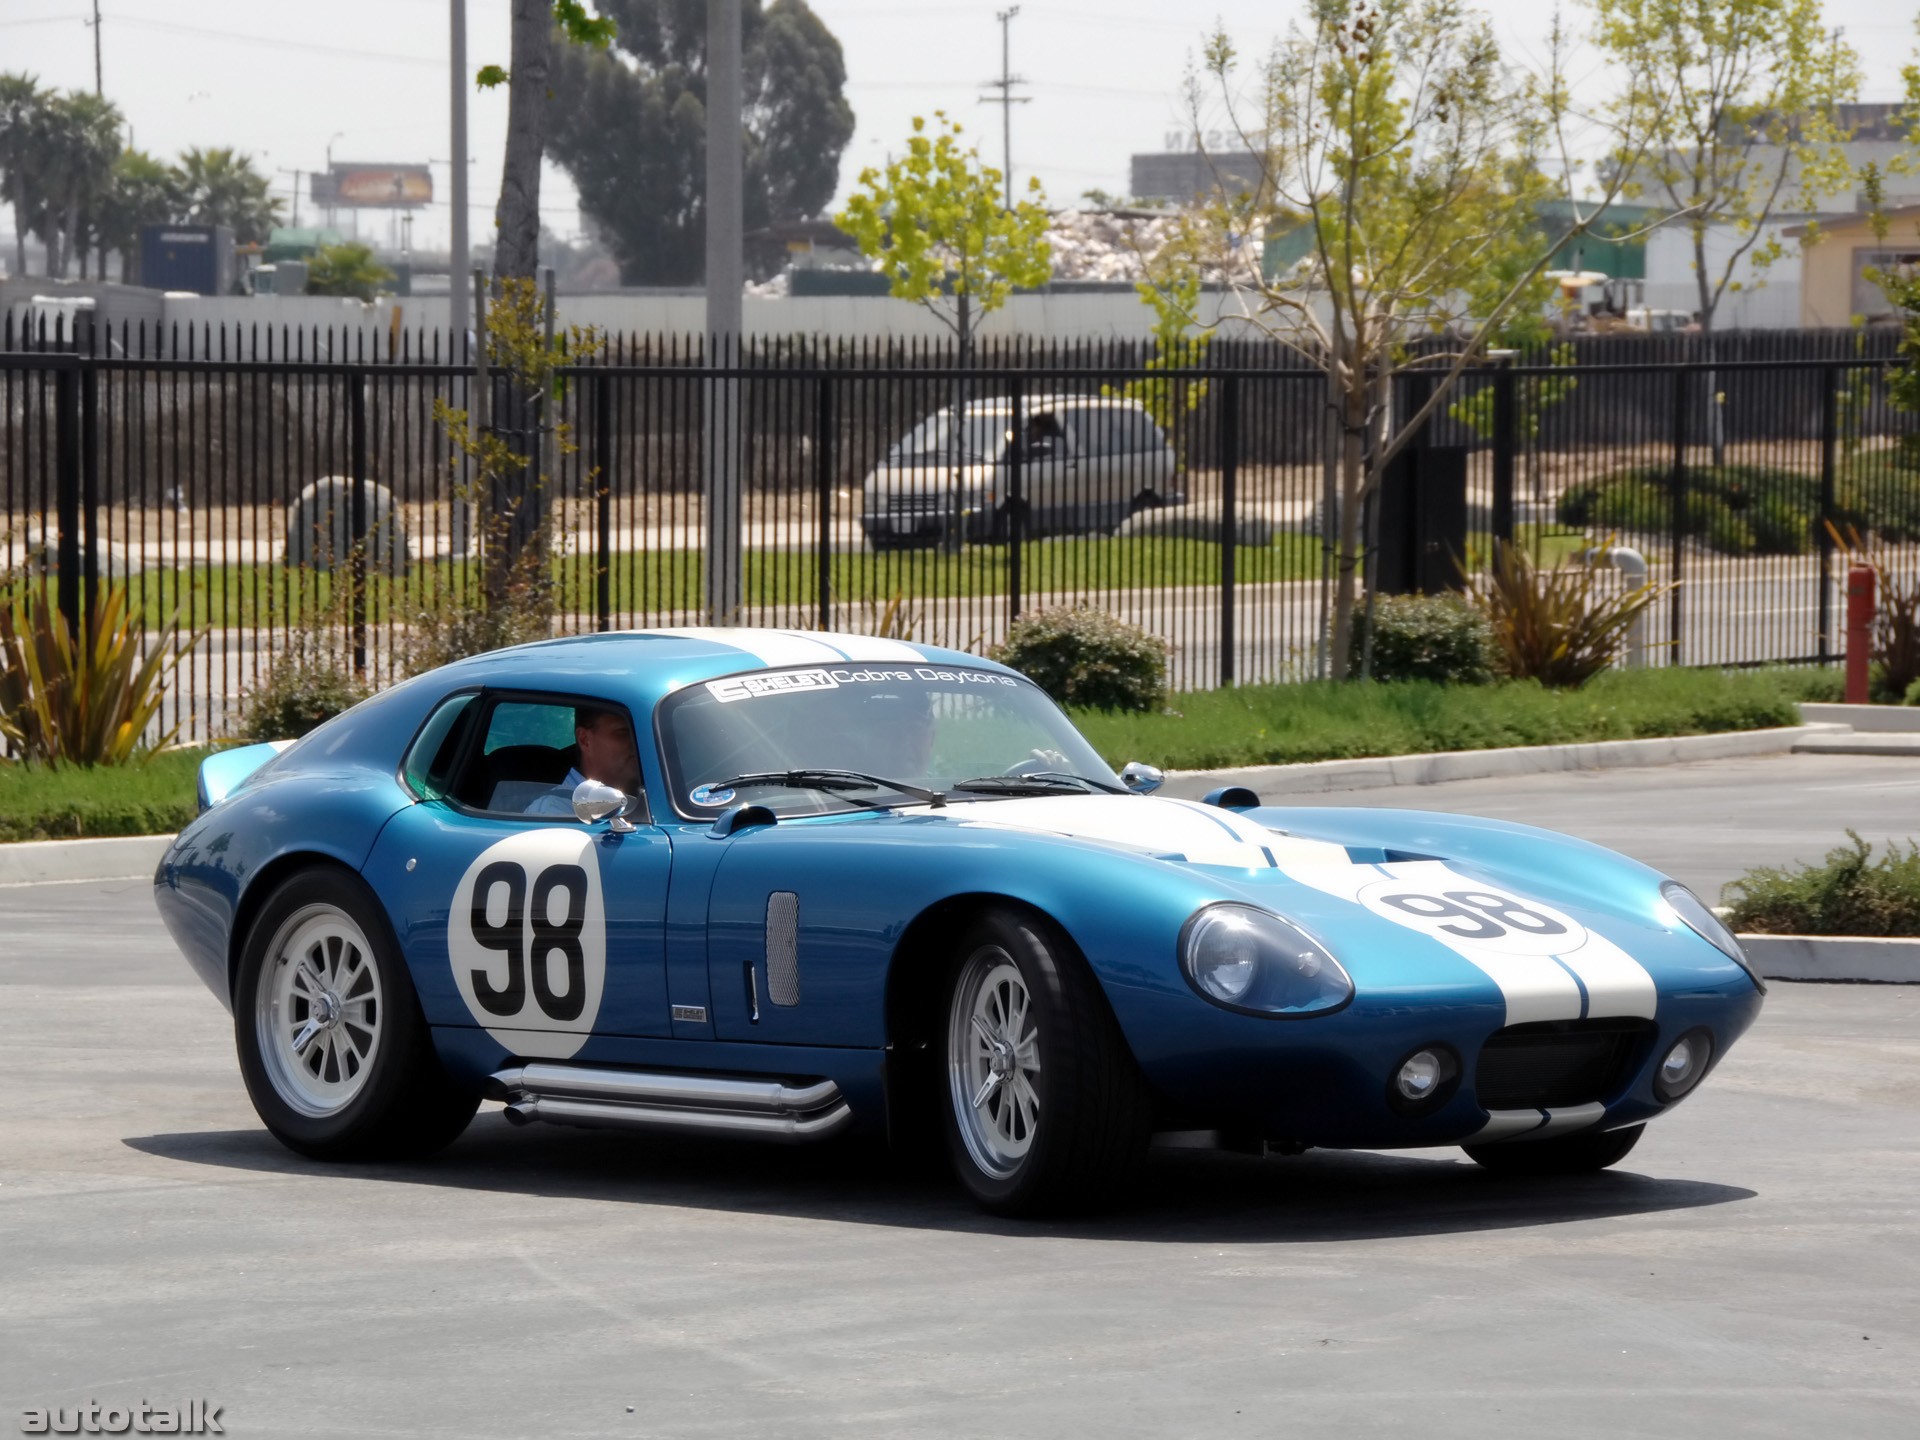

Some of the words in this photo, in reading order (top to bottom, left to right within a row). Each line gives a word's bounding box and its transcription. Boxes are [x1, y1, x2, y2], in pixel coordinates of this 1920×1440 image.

[744, 673, 828, 693] SHELBY
[832, 669, 912, 684] Cobra
[914, 668, 1018, 687] Daytona
[1379, 891, 1568, 939] 98
[470, 860, 588, 1022] 98
